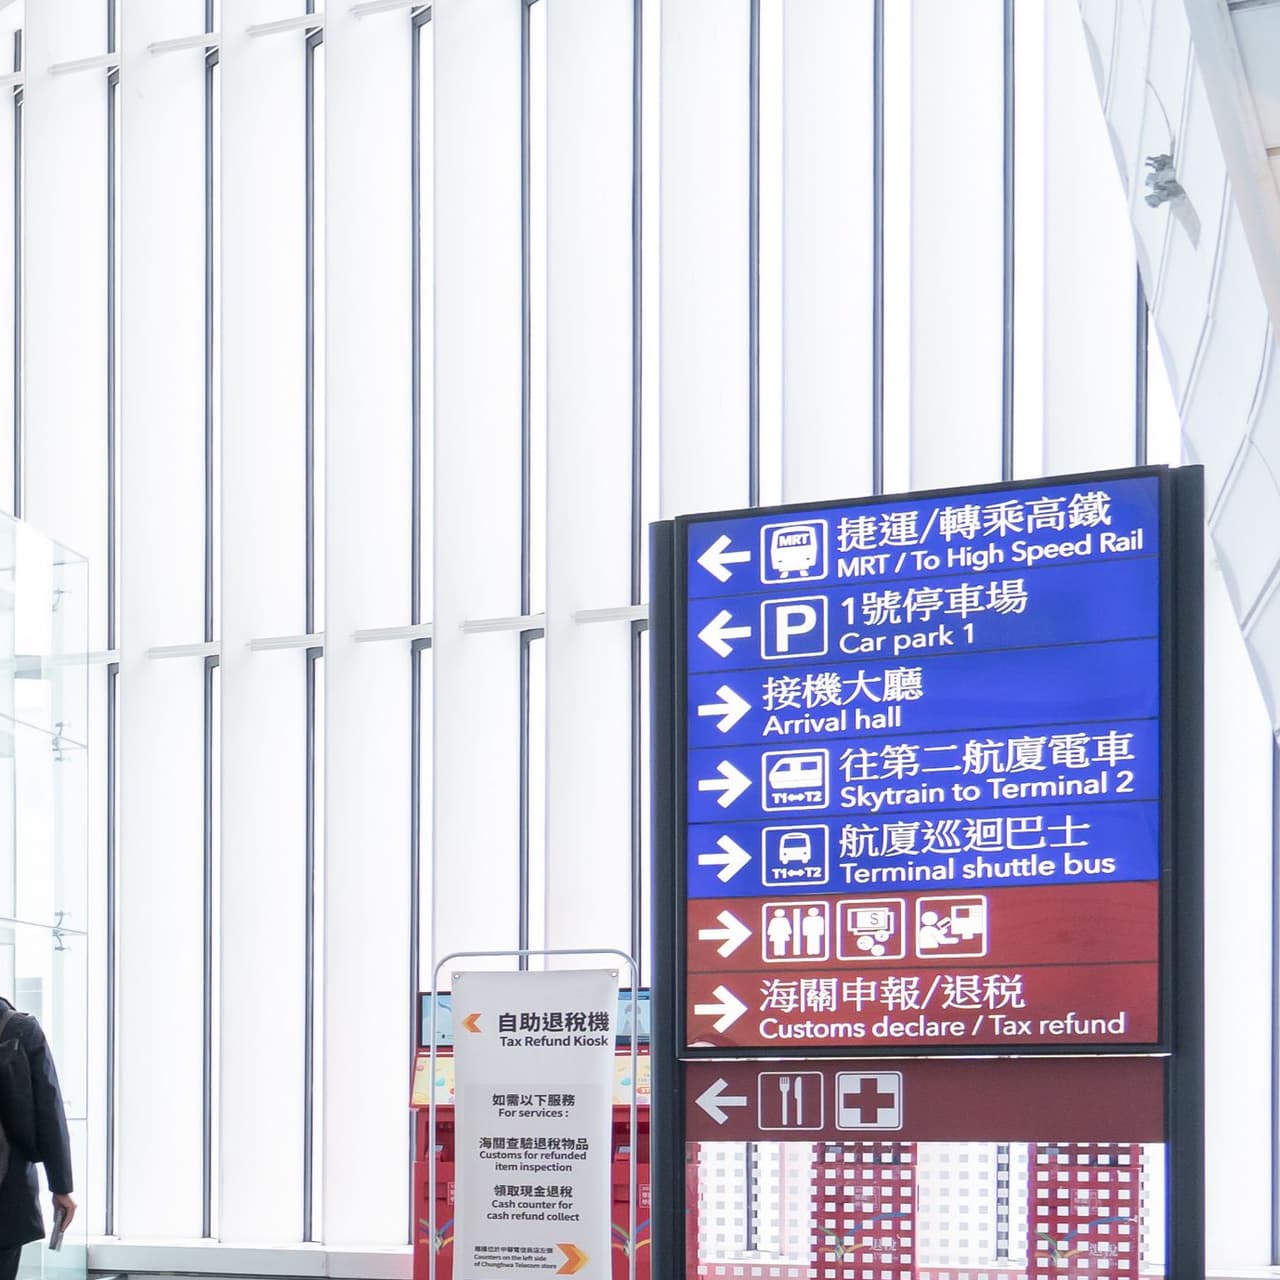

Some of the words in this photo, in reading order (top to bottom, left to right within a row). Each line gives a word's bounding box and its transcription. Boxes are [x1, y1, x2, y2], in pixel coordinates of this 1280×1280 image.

[837, 491, 1111, 553] 捷運/轉乘高鐵
[779, 533, 810, 547] MRT
[838, 554, 890, 577] MRT
[911, 551, 940, 570] To
[948, 543, 1003, 571] High
[1012, 534, 1091, 566] Speed
[1101, 529, 1142, 553] Rail
[842, 579, 1028, 626] 1號停車場
[840, 633, 886, 653] Car
[894, 624, 953, 655] park
[964, 623, 972, 643] 1
[762, 667, 923, 711] 接機大廳
[763, 710, 846, 735] Arrival
[856, 706, 900, 729] hall
[840, 731, 1134, 782] 往第二航廈電車
[841, 783, 944, 812] Skytrain
[952, 784, 980, 801] to
[987, 771, 1107, 799] Terminal
[1116, 771, 1133, 792] 2
[840, 815, 1089, 858] 航廈巡迴巴士
[840, 858, 954, 883] Terminal
[963, 854, 1055, 879] shuttle
[1065, 853, 1115, 874] bus
[499, 1012, 609, 1032] 自助退稅機
[760, 1018, 865, 1038] Customs
[872, 1015, 964, 1037] declare
[989, 1015, 1031, 1035] Tax
[1040, 1012, 1124, 1034] refund
[500, 1037, 521, 1046] Tax
[525, 1036, 570, 1046] Refund
[574, 1035, 608, 1046] Kiosk
[493, 1094, 575, 1106] 如需以下服務
[499, 1109, 517, 1117] For
[480, 1151, 522, 1159] Customs
[524, 1151, 538, 1159] for
[541, 1151, 586, 1159] refunded
[520, 1163, 572, 1173] inspection
[487, 1211, 509, 1219] cash
[512, 1212, 544, 1220] refund
[547, 1213, 579, 1221] collect
[492, 1200, 515, 1208] Cash
[559, 1201, 572, 1209] for
